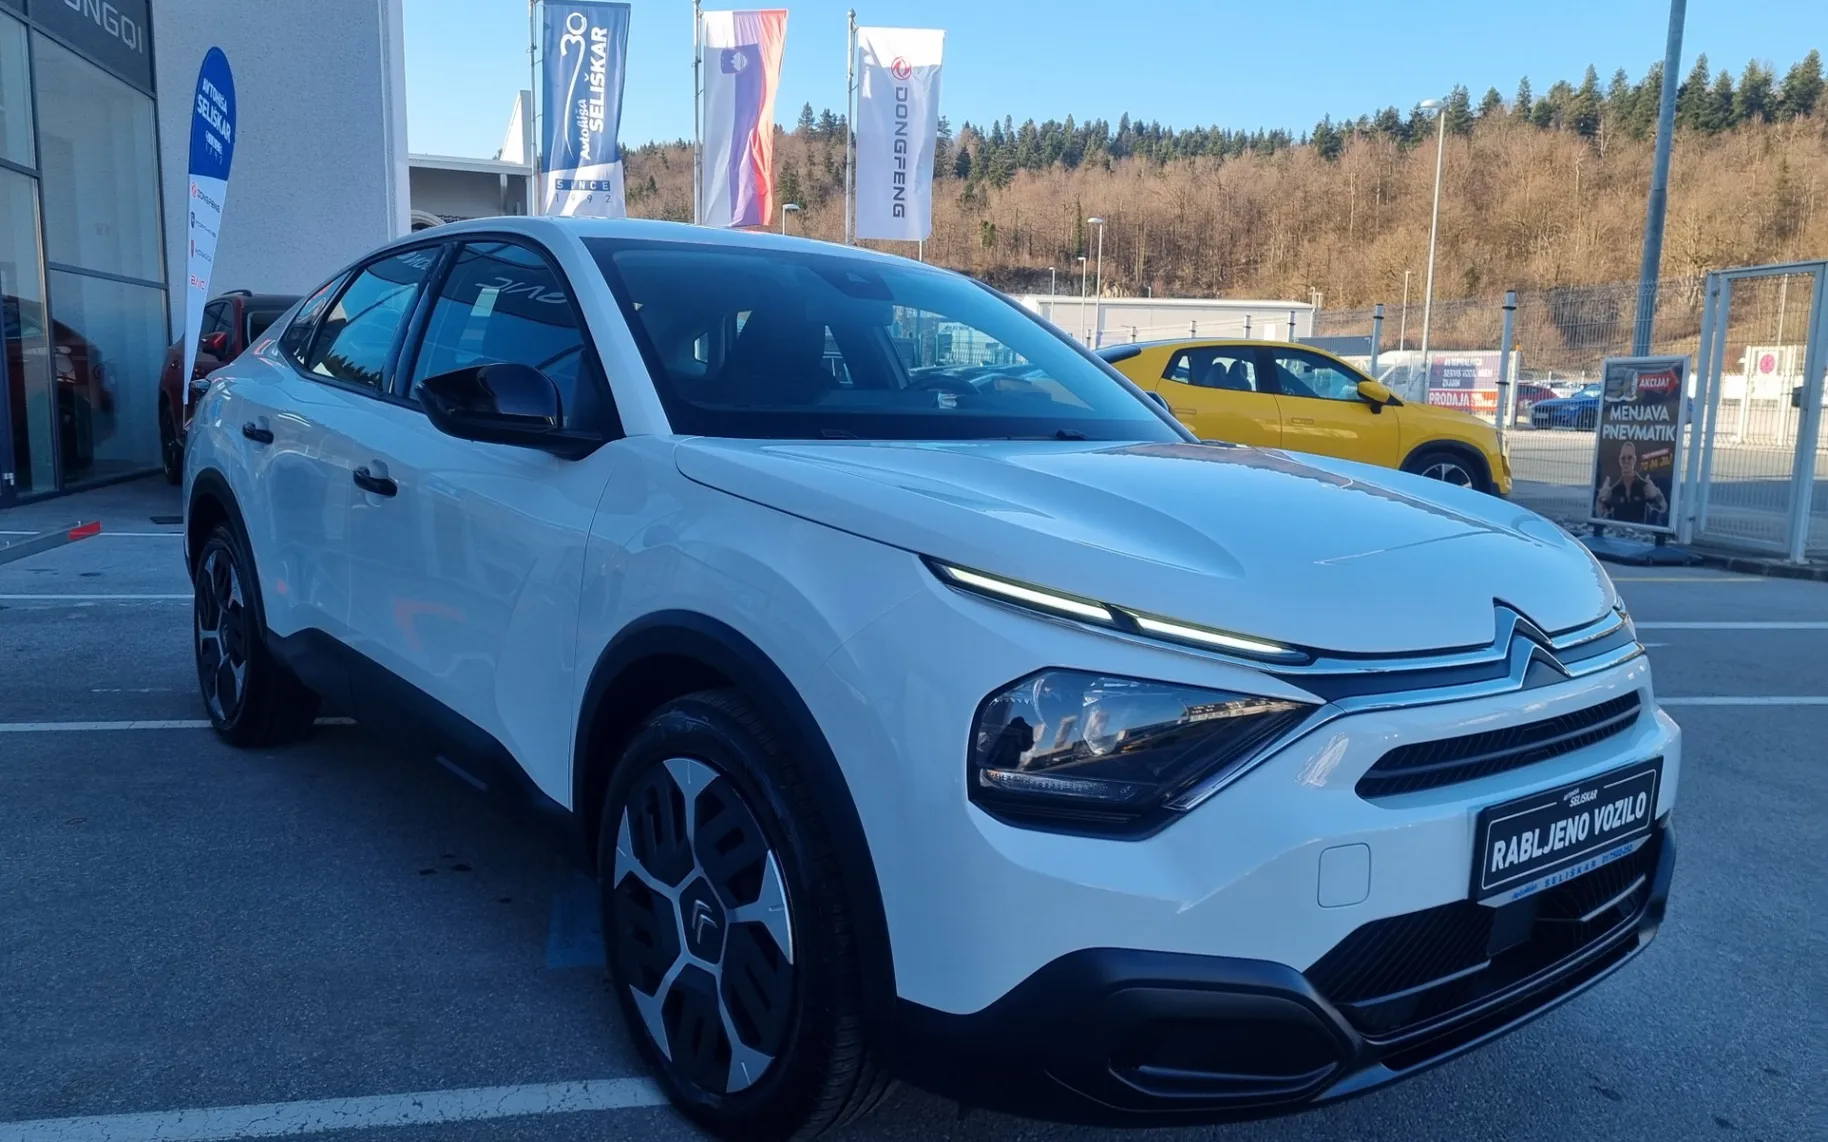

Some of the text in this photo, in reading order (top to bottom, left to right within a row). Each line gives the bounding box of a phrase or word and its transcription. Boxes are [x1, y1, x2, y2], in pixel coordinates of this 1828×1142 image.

[584, 27, 607, 133] SELIŠKAR
[893, 86, 908, 218] DONGFENG
[556, 180, 610, 190] SINCE
[1429, 392, 1470, 407] PRODAJA
[1610, 405, 1670, 421] MENJAVA
[1602, 424, 1677, 441] PNEVMATIK
[1491, 811, 1590, 873] RABLJENO
[1594, 791, 1647, 836] VOZILO
